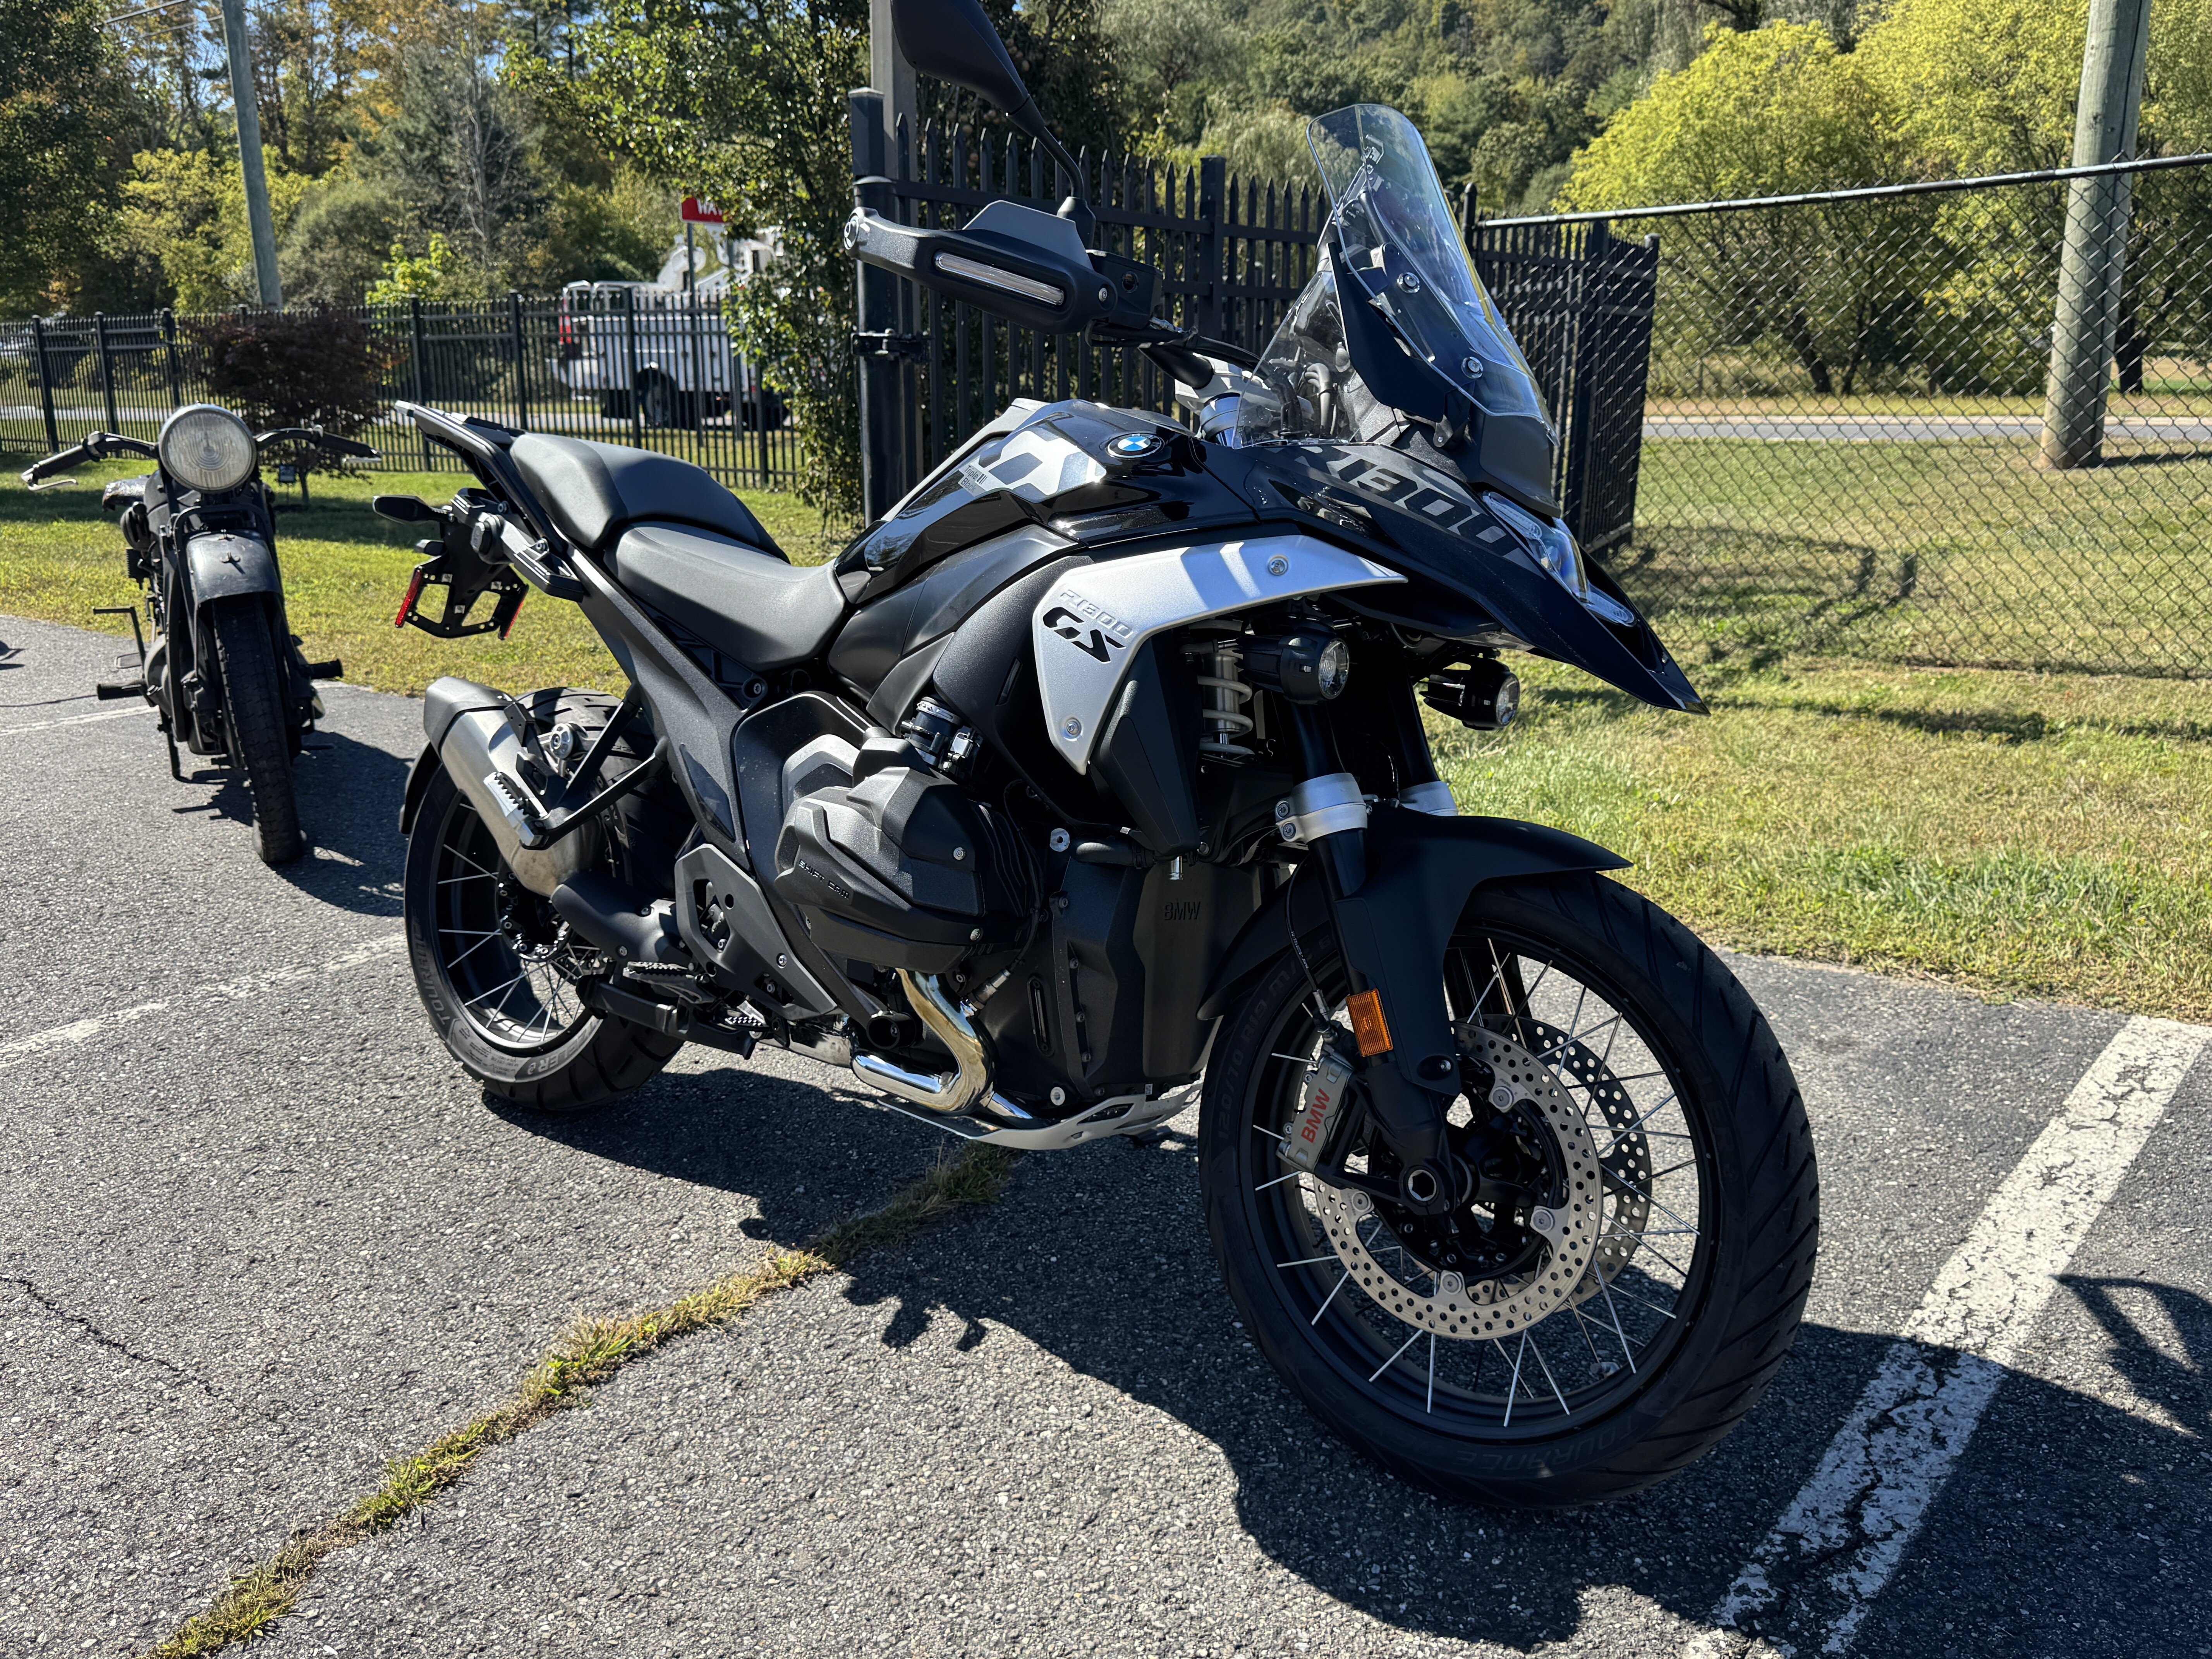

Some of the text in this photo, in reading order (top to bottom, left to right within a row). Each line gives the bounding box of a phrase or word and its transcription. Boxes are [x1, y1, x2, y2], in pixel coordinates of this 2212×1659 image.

[961, 477, 976, 493] Black
[964, 465, 979, 480] Triple
[1042, 606, 1127, 664] GS
[799, 859, 850, 900] SHIFT CAM
[1164, 901, 1201, 921] BMW
[1218, 1049, 1245, 1139] 120/70
[1240, 999, 1268, 1044] R19
[1301, 1087, 1330, 1144] BMW
[1450, 1414, 1640, 1470] TOURANCE
